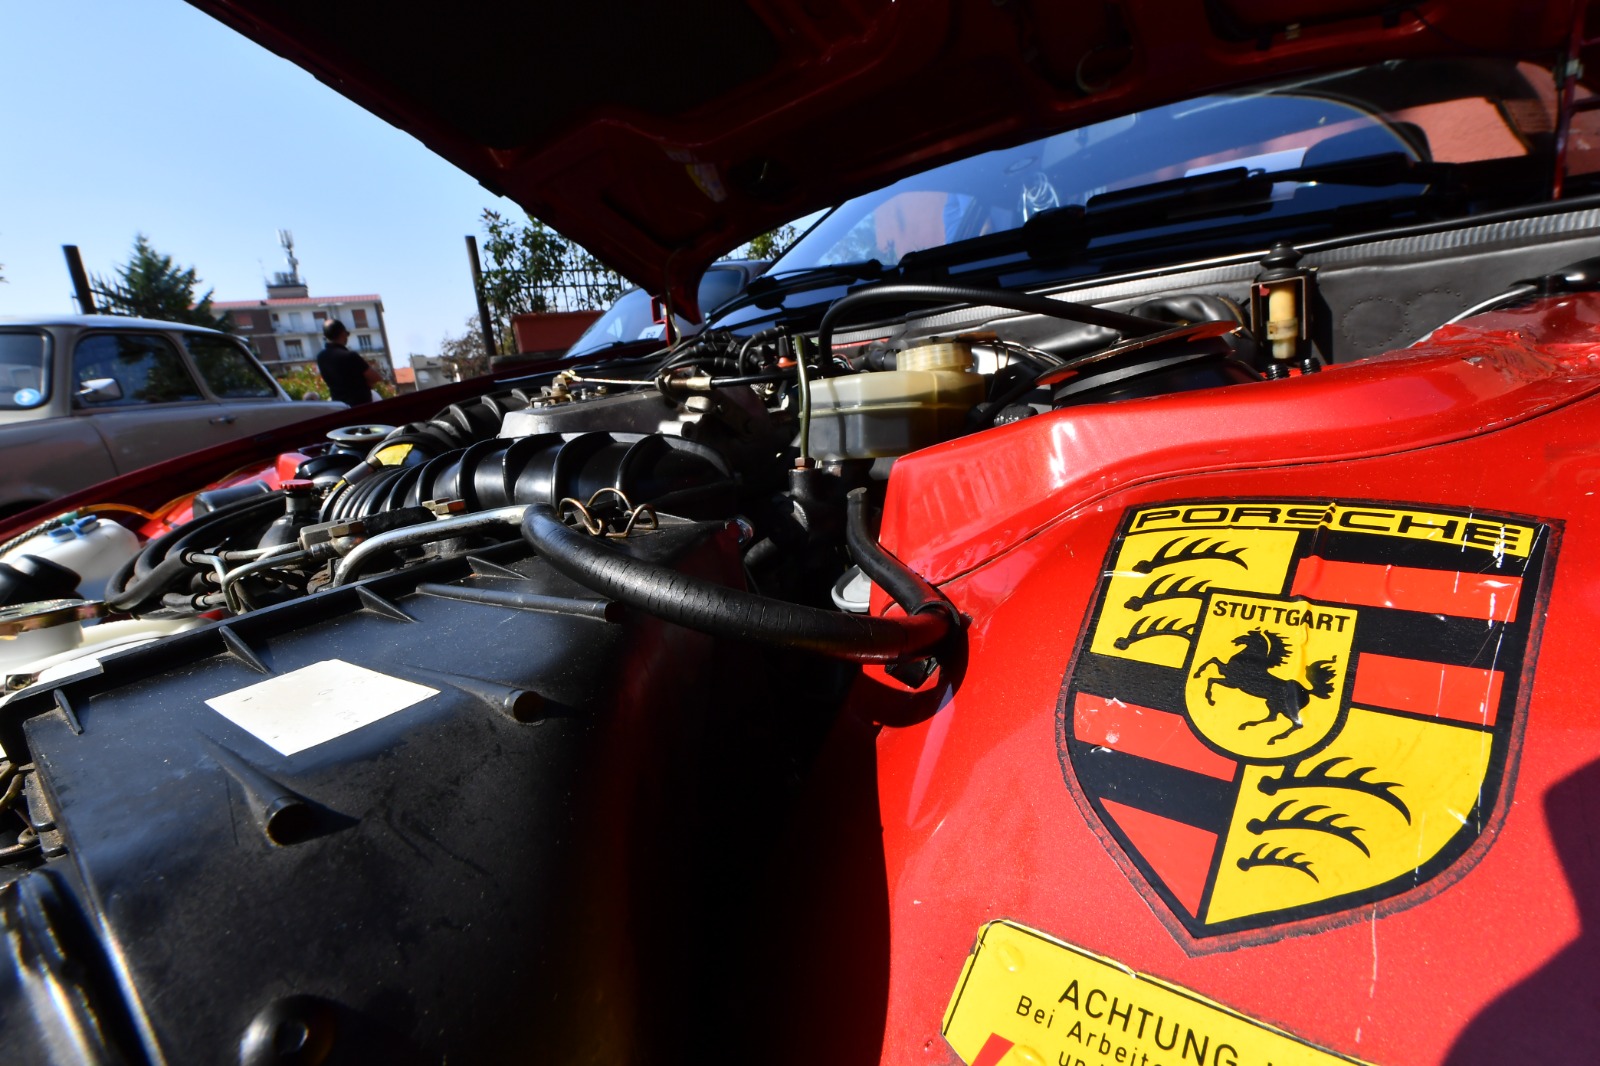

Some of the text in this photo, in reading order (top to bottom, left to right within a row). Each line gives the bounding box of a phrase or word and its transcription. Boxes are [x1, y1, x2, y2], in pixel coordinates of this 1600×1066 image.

[1135, 506, 1522, 551] PORSCHE
[1212, 600, 1351, 633] STUTTGART
[1016, 995, 1163, 1066] Bei Arbeit
[1057, 979, 1239, 1066] ACHTUNG
